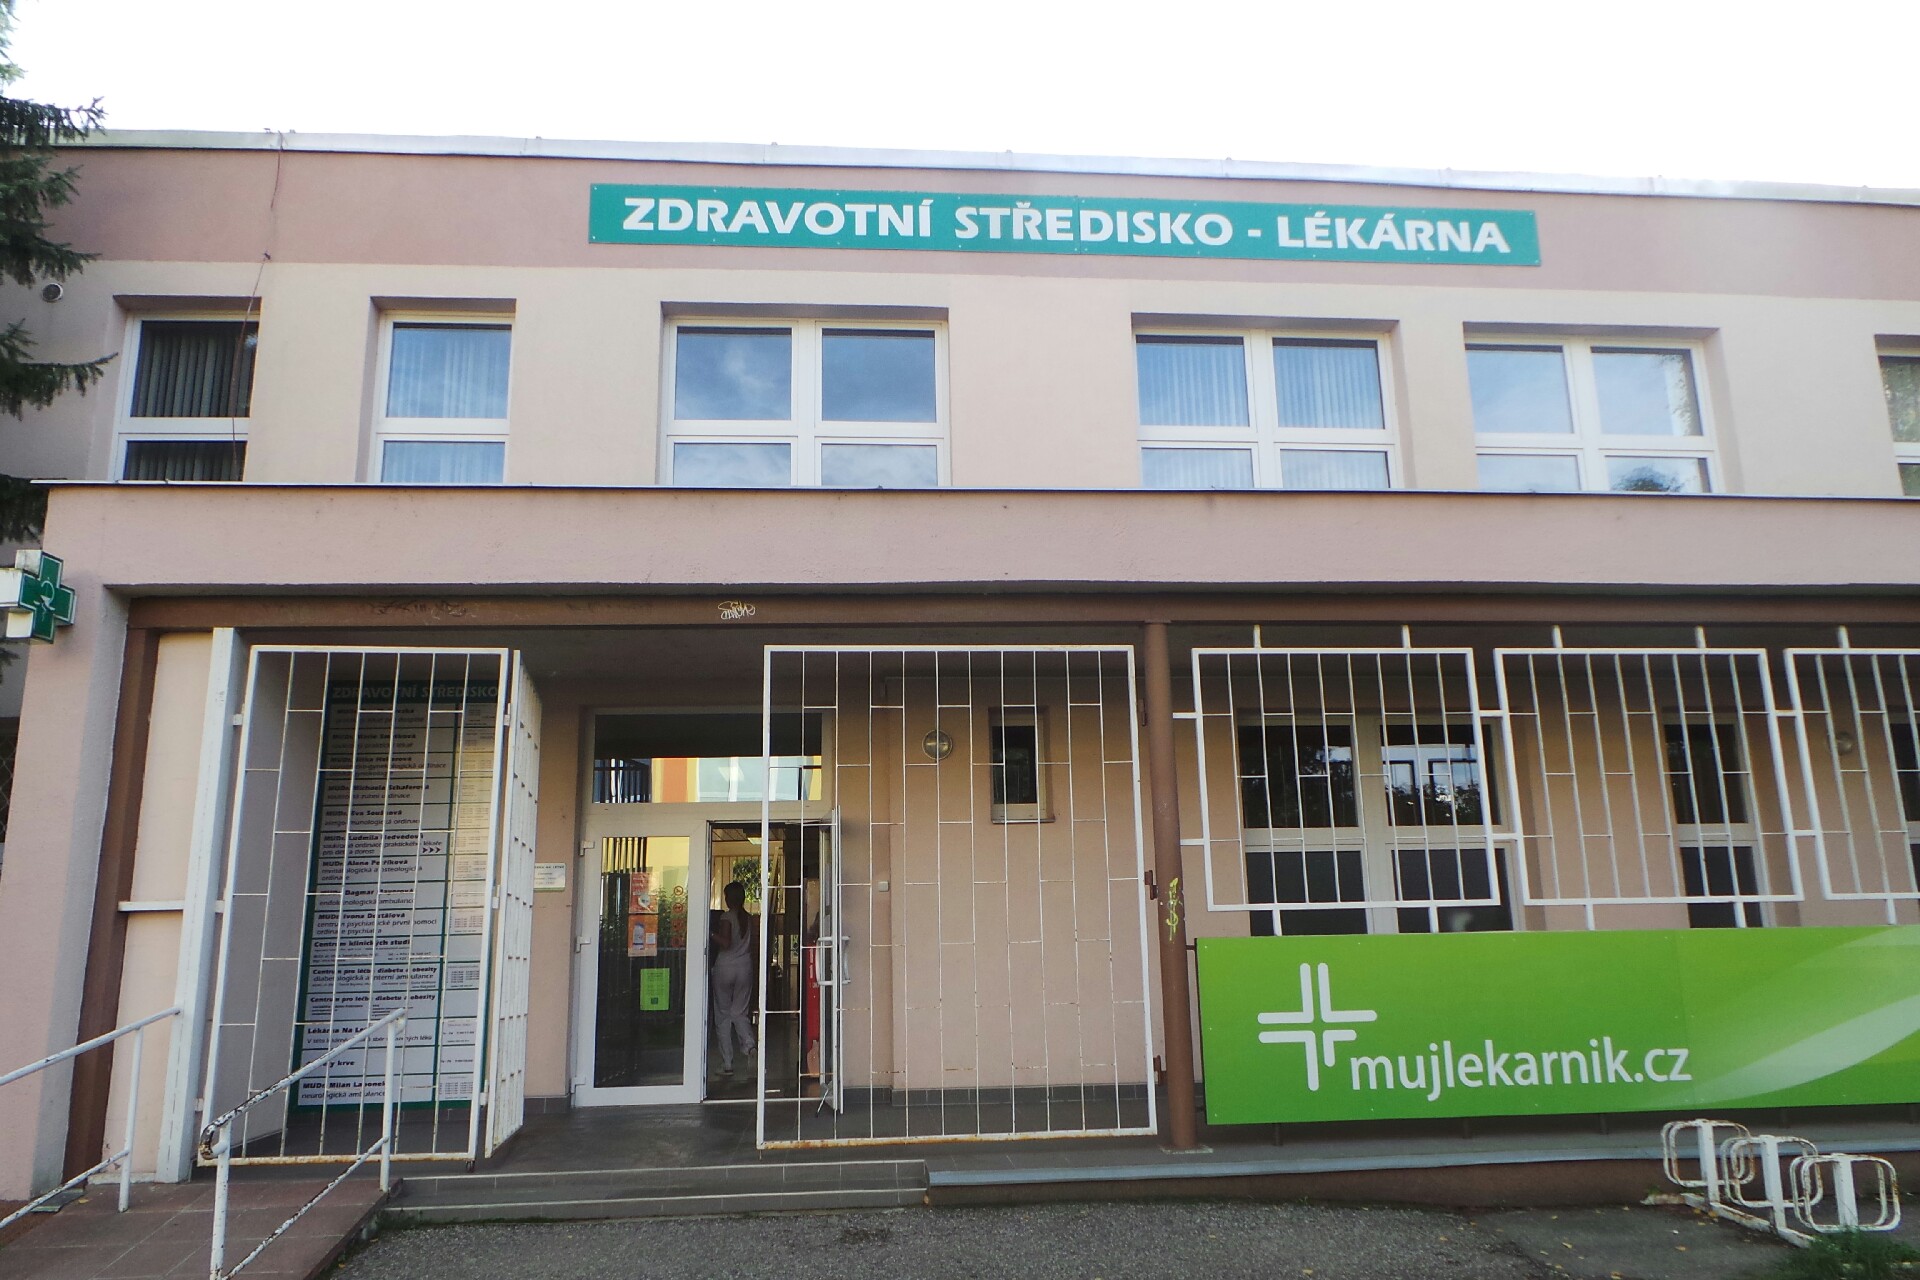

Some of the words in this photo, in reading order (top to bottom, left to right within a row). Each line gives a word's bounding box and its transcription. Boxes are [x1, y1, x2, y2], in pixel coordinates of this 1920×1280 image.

[623, 198, 933, 237] ZDRAVOTNÍ
[954, 204, 1234, 247] STŘEDISKO
[1277, 208, 1511, 255] LÉKÁRNA
[337, 1059, 355, 1067] krve
[1350, 1036, 1692, 1101] mujlekarnik.cz
